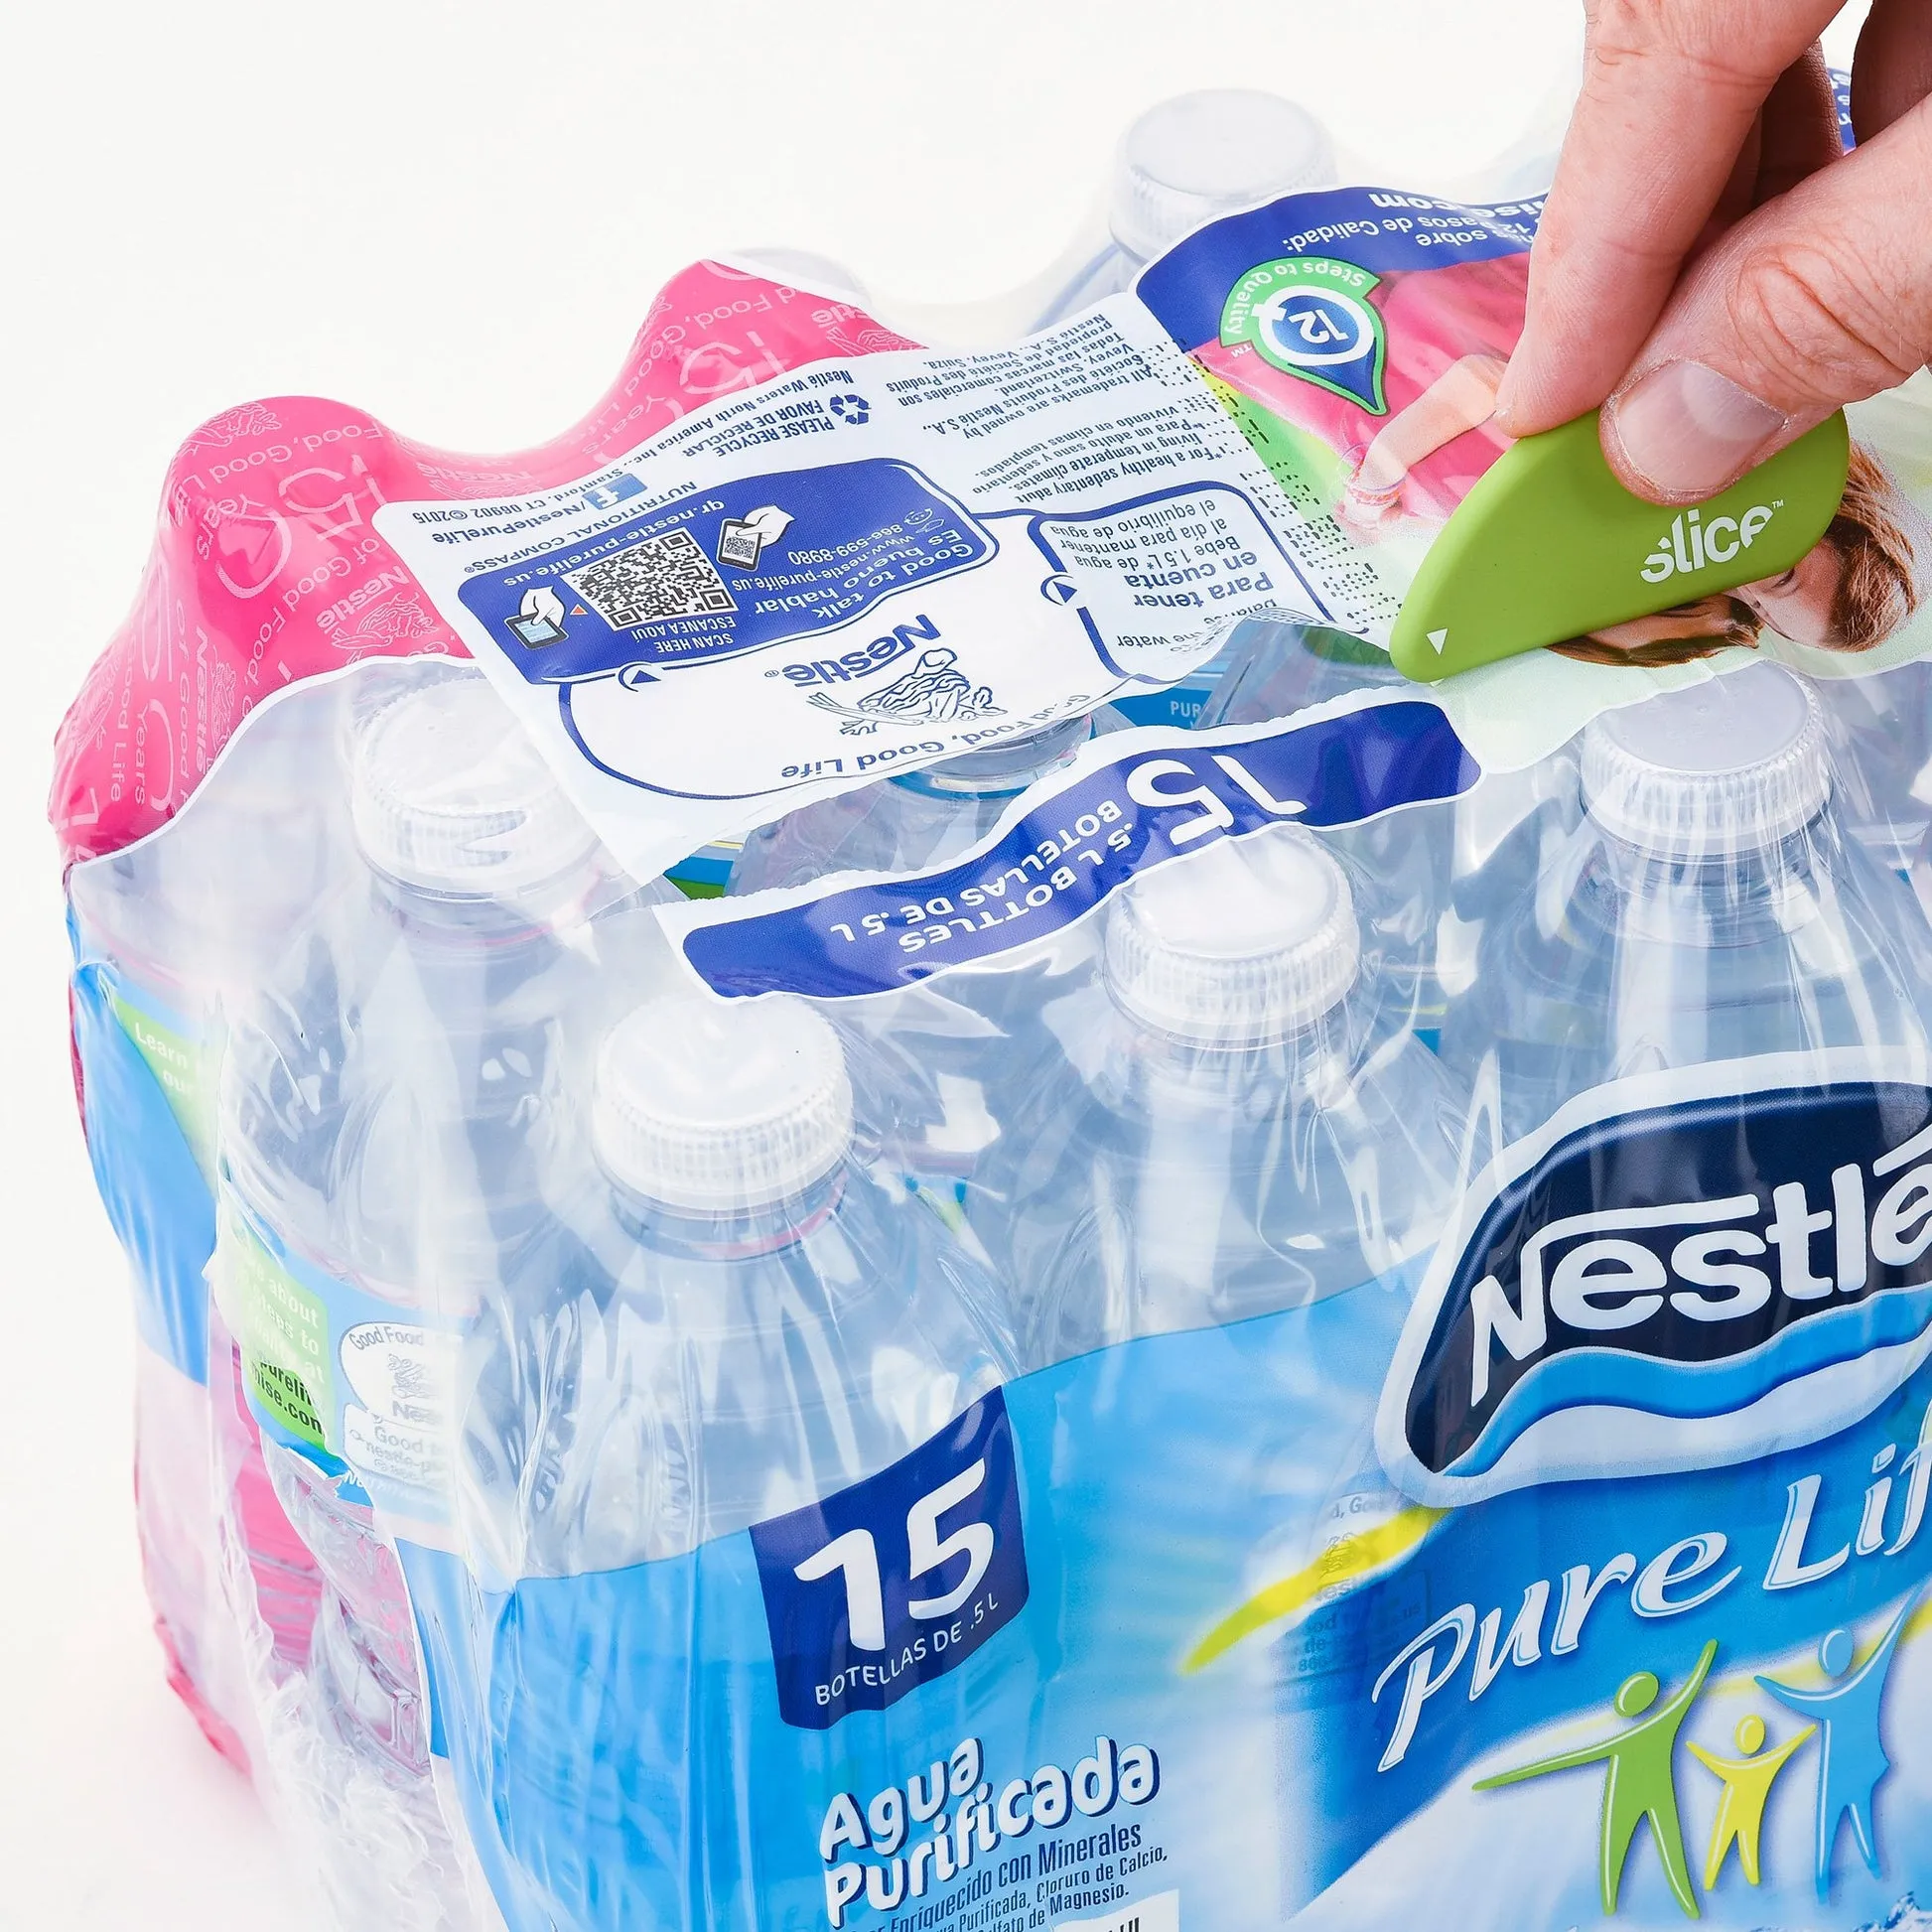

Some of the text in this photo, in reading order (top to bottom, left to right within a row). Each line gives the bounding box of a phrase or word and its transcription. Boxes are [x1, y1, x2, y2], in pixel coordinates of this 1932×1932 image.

[1283, 220, 1379, 252] Calidad:
[1382, 217, 1413, 233] de
[1415, 230, 1487, 246] sobre
[681, 291, 773, 329] Food,
[1222, 258, 1369, 337] Steps to Quality
[1059, 314, 1106, 338] Nestlé
[1287, 306, 1349, 347] 12
[886, 319, 1113, 392] propiedad de Société des Produits
[897, 332, 1125, 406] Todas las marcas comerciales son
[922, 358, 966, 368] Suiza.
[994, 363, 1082, 396] Switzerland.
[963, 363, 1153, 439] All trademarks are owned by
[1003, 383, 1062, 408] Produits
[1062, 374, 1087, 386] des
[289, 418, 385, 452] Food,
[579, 395, 665, 457] Years
[682, 400, 824, 457] FAVOR DE RECICLAR
[712, 416, 835, 457] PLEASE RECYCLE
[958, 403, 1005, 427] Nestlé
[205, 441, 295, 484] Good
[412, 370, 854, 524] Nestlé Waters North America CT 06902 ©2015
[972, 427, 1152, 493] un adulto sano y sedentario
[975, 406, 1179, 477] viviendo en climas templados.
[1009, 433, 1202, 490] living in temperate climates.
[1120, 455, 1176, 476] healthy
[1174, 452, 1185, 462] a
[1015, 487, 1053, 503] adult
[1052, 468, 1119, 494] sedentary
[194, 491, 263, 563] Years
[432, 500, 586, 544] /NestlePureLife
[567, 482, 697, 538] NUTRITIONAL
[1049, 499, 1215, 539] el equilibrio de agua
[503, 500, 725, 586] qr.nestle-purelife.us
[787, 524, 903, 564] 866-599-8980
[1060, 518, 1227, 558] al día para mantener
[1074, 552, 1113, 568] agua
[1164, 549, 1191, 568] 1.5
[1194, 536, 1241, 556] Bebe
[732, 535, 915, 591] www.nestle-purelife.us
[755, 529, 962, 614] Es bueno hablar
[811, 544, 973, 619] Good to talk
[1117, 557, 1139, 571] de
[1123, 552, 1257, 590] en cuenta
[244, 532, 383, 686] of Good Food,
[312, 564, 410, 636] Nestlé
[1134, 571, 1274, 608] Para tener
[630, 616, 737, 643] ESCANEA AQUÍ
[653, 633, 734, 652] SCAN HERE
[1117, 635, 1170, 648] water
[177, 670, 190, 777] Good
[108, 740, 127, 802] Life
[133, 705, 147, 805] Years
[781, 721, 1035, 778] Food, Good Life
[1119, 745, 1310, 850] 15
[830, 800, 1123, 941] BOTELLAS DE .5 L
[898, 823, 1133, 953] .5 L BOTTLES
[135, 1021, 191, 1070] Learn
[267, 1278, 320, 1330] about
[297, 1327, 321, 1357] to
[347, 1324, 384, 1351] Good
[791, 1454, 994, 1650] 15
[815, 1592, 998, 1706] BOTELLAS DE .5 L
[1372, 1532, 1740, 1773] Pure
[820, 1736, 984, 1861] Agua
[823, 1734, 1161, 1931] Purificada
[891, 1823, 1142, 1932] Enriquecido con Minerales
[959, 1846, 1168, 1932] Purificada, Cloruro de Calcio,
[1029, 1908, 1045, 1929] de
[1049, 1882, 1130, 1916] Magnesio.
